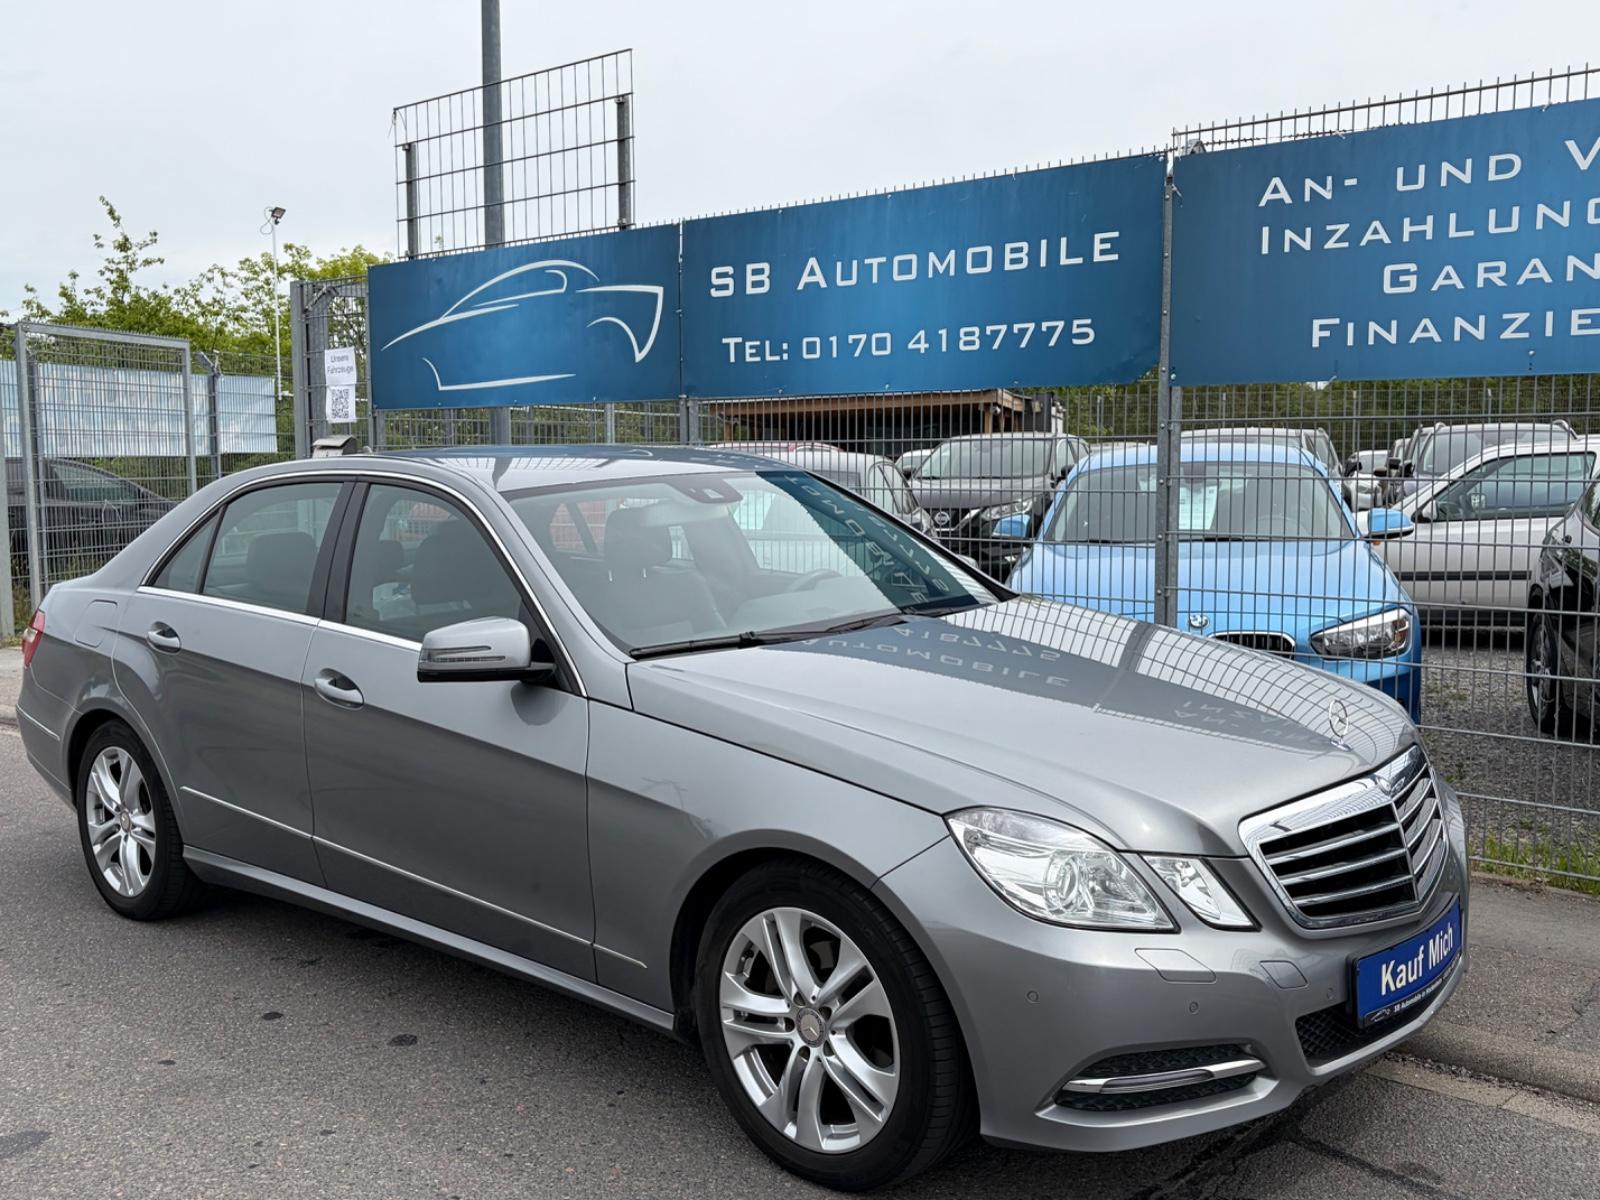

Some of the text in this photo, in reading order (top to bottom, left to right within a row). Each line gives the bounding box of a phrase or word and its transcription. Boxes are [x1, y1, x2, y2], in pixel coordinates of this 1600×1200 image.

[1258, 175, 1358, 207] AN-
[1396, 153, 1522, 192] UND
[709, 231, 1120, 297] SB AUTOMOBILE
[721, 318, 1096, 363] TEL: 0170 4187775
[1381, 944, 1425, 996] Kauf
[1428, 922, 1453, 970] Mich
